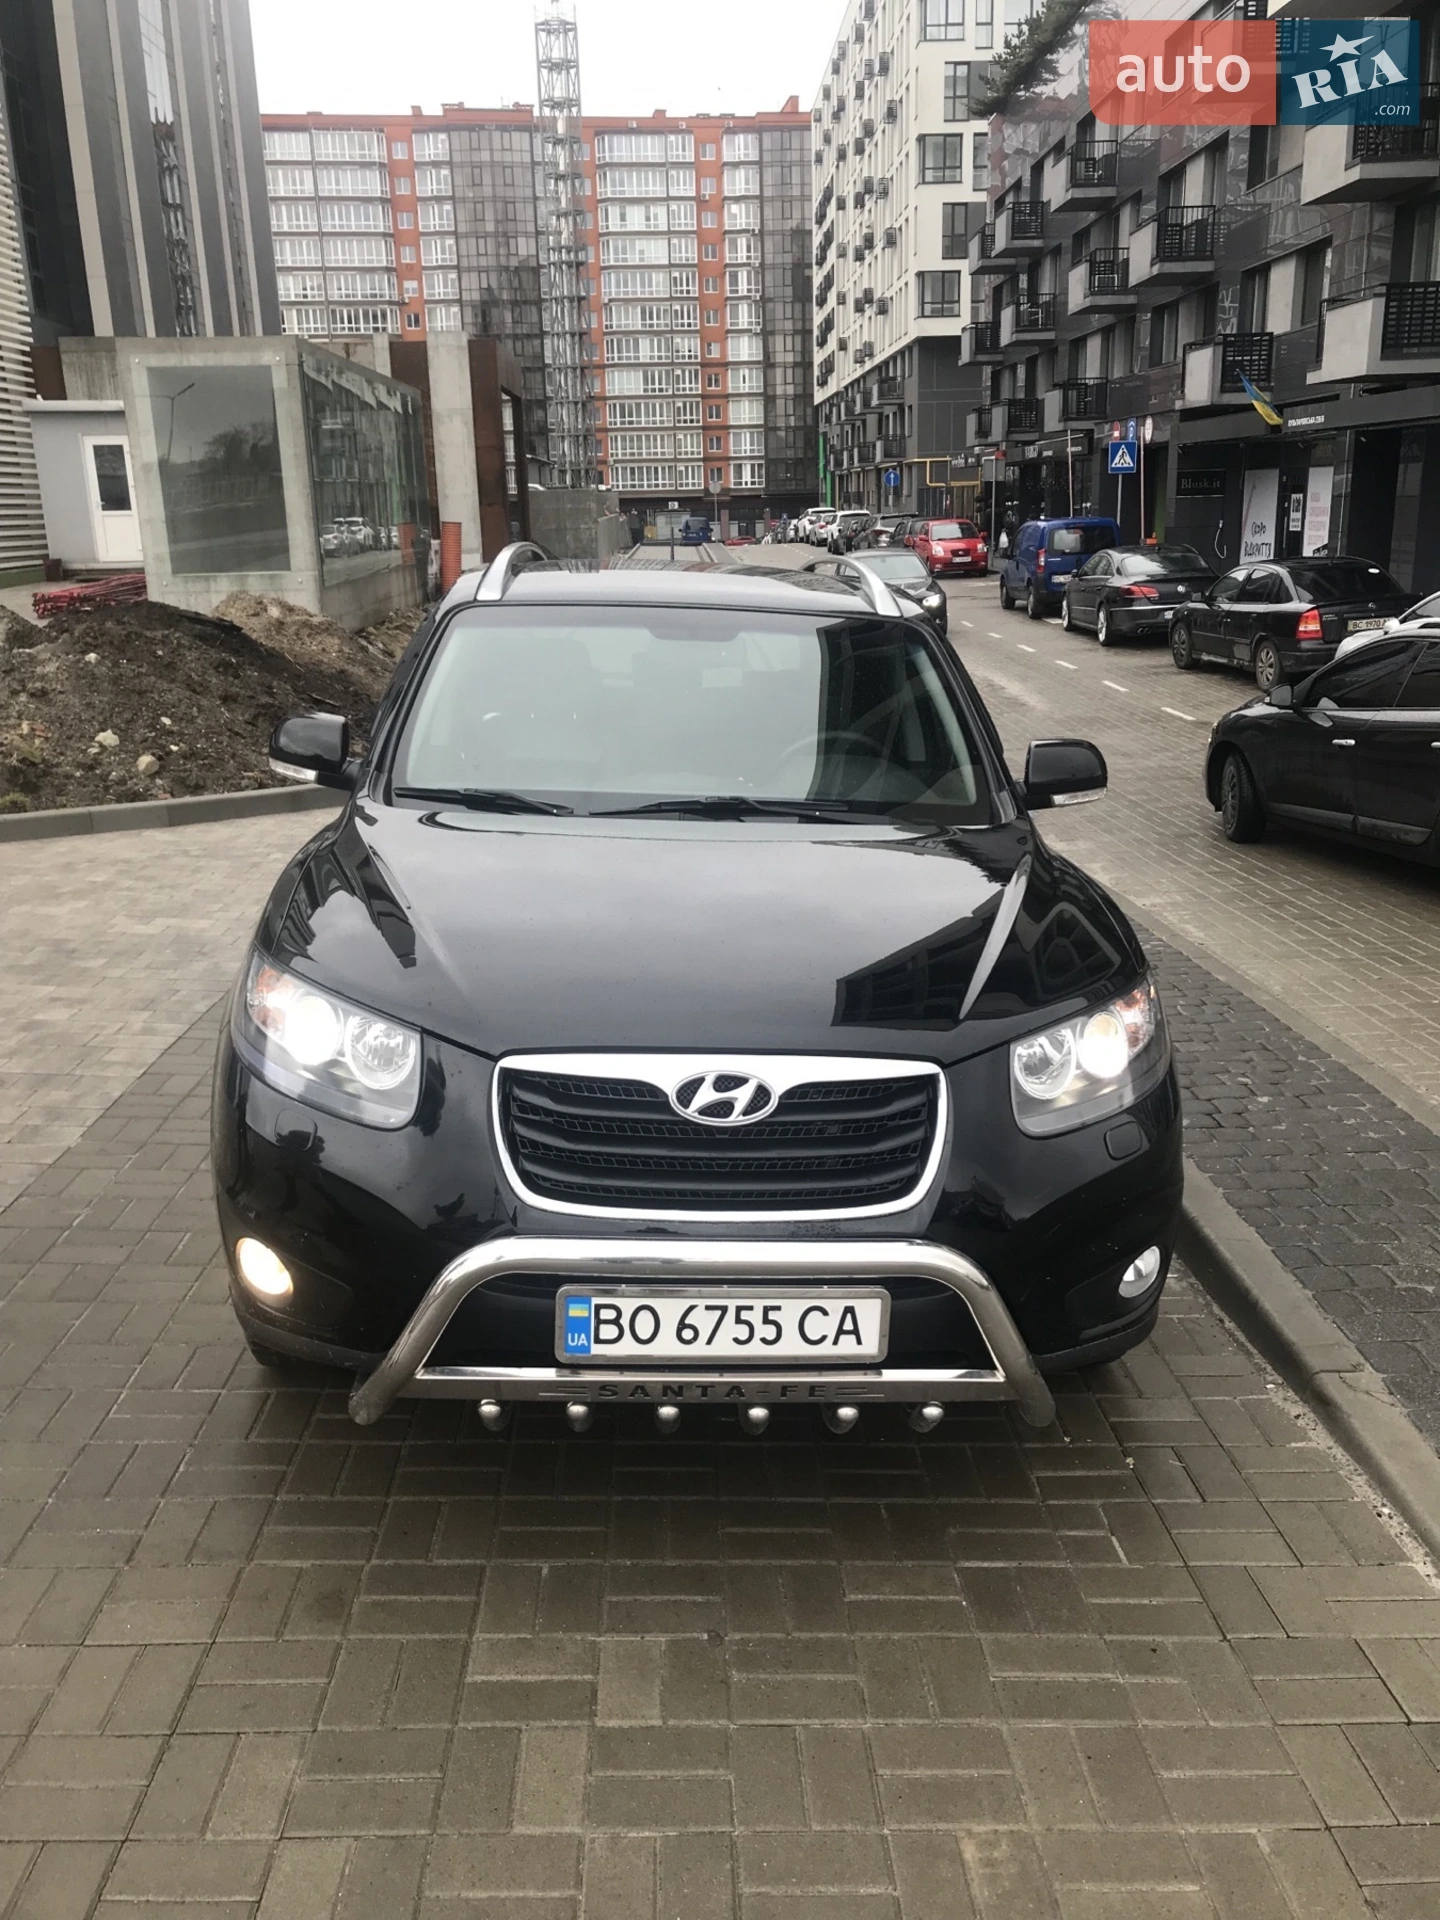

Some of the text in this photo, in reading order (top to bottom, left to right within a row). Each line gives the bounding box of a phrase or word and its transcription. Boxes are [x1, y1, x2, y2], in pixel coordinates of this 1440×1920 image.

[1365, 619, 1381, 628] 1970
[593, 1303, 864, 1346] BO 6755 CA
[567, 1332, 589, 1347] UA
